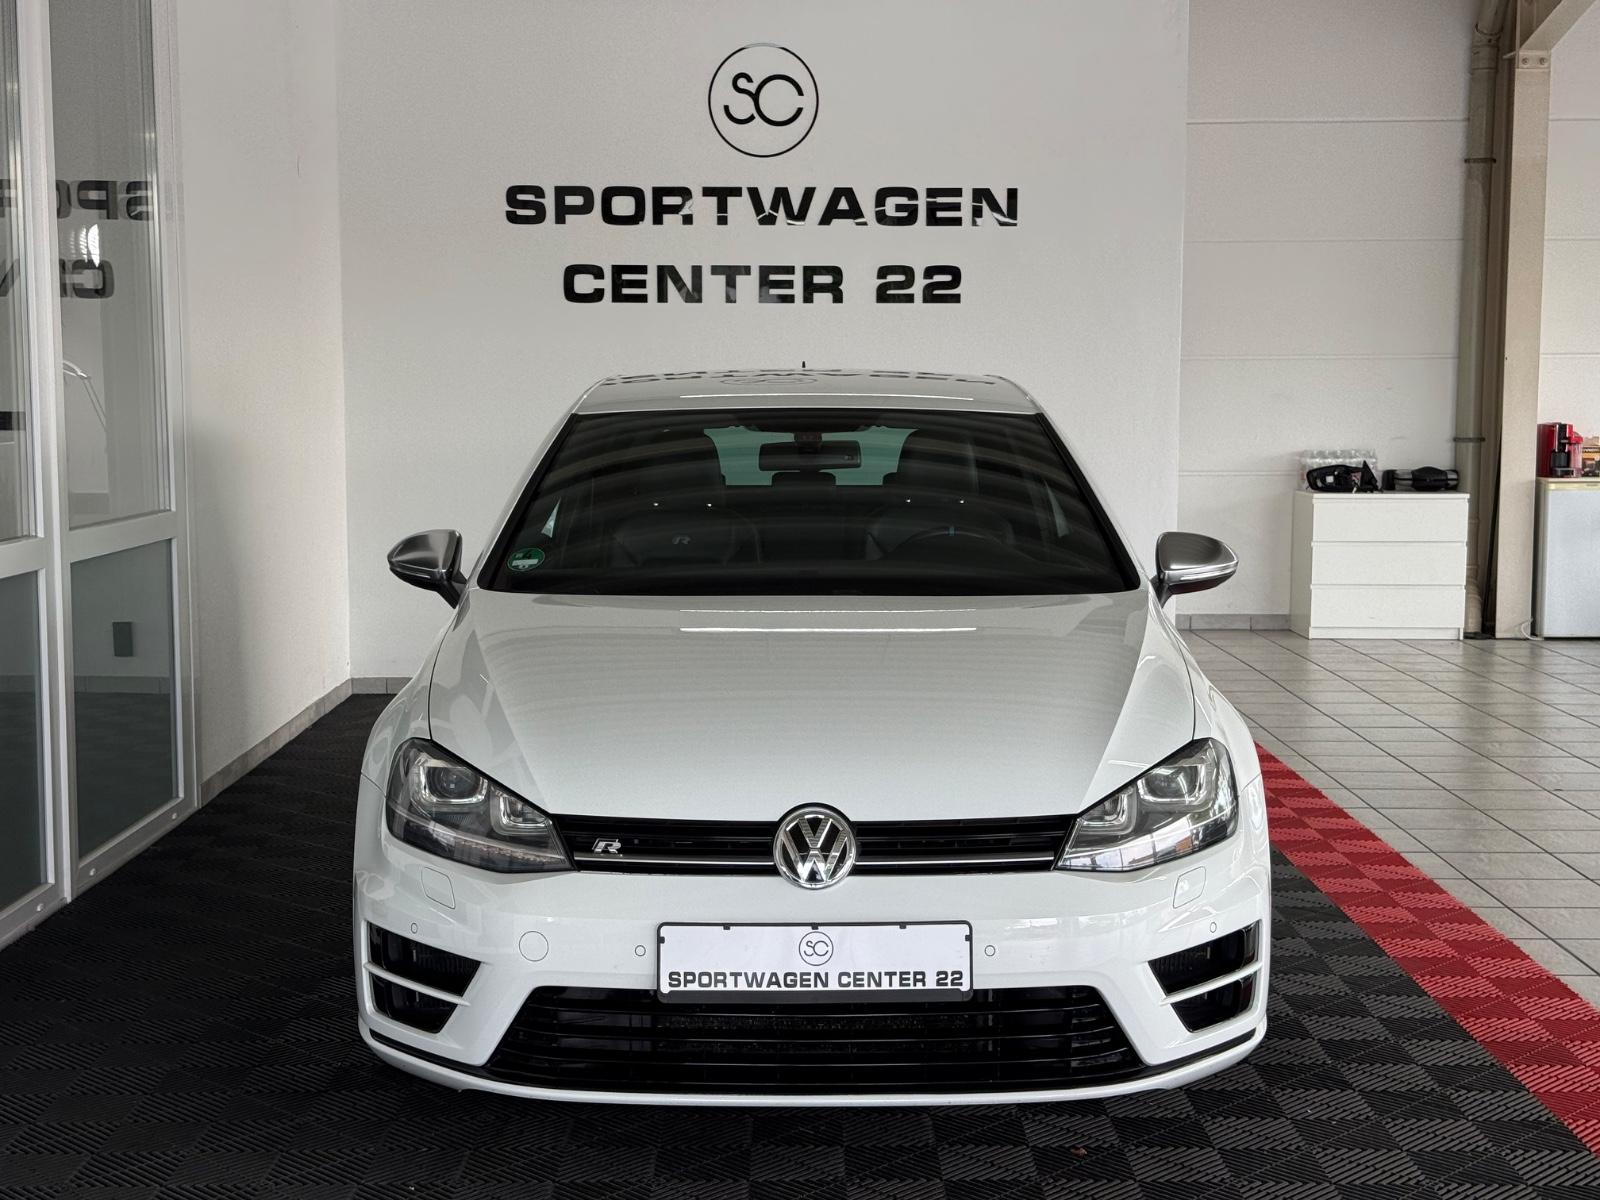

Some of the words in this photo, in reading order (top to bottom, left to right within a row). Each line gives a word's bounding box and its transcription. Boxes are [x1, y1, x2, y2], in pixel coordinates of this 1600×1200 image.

[723, 72, 804, 127] SC
[505, 184, 1019, 227] SPORTWAGEN
[562, 263, 844, 304] CENTER
[875, 264, 962, 304] 22
[592, 838, 622, 853] R
[803, 940, 829, 957] SC
[668, 971, 829, 988] SPORTWAGEN
[837, 970, 926, 987] CENTER
[935, 970, 964, 987] 22
